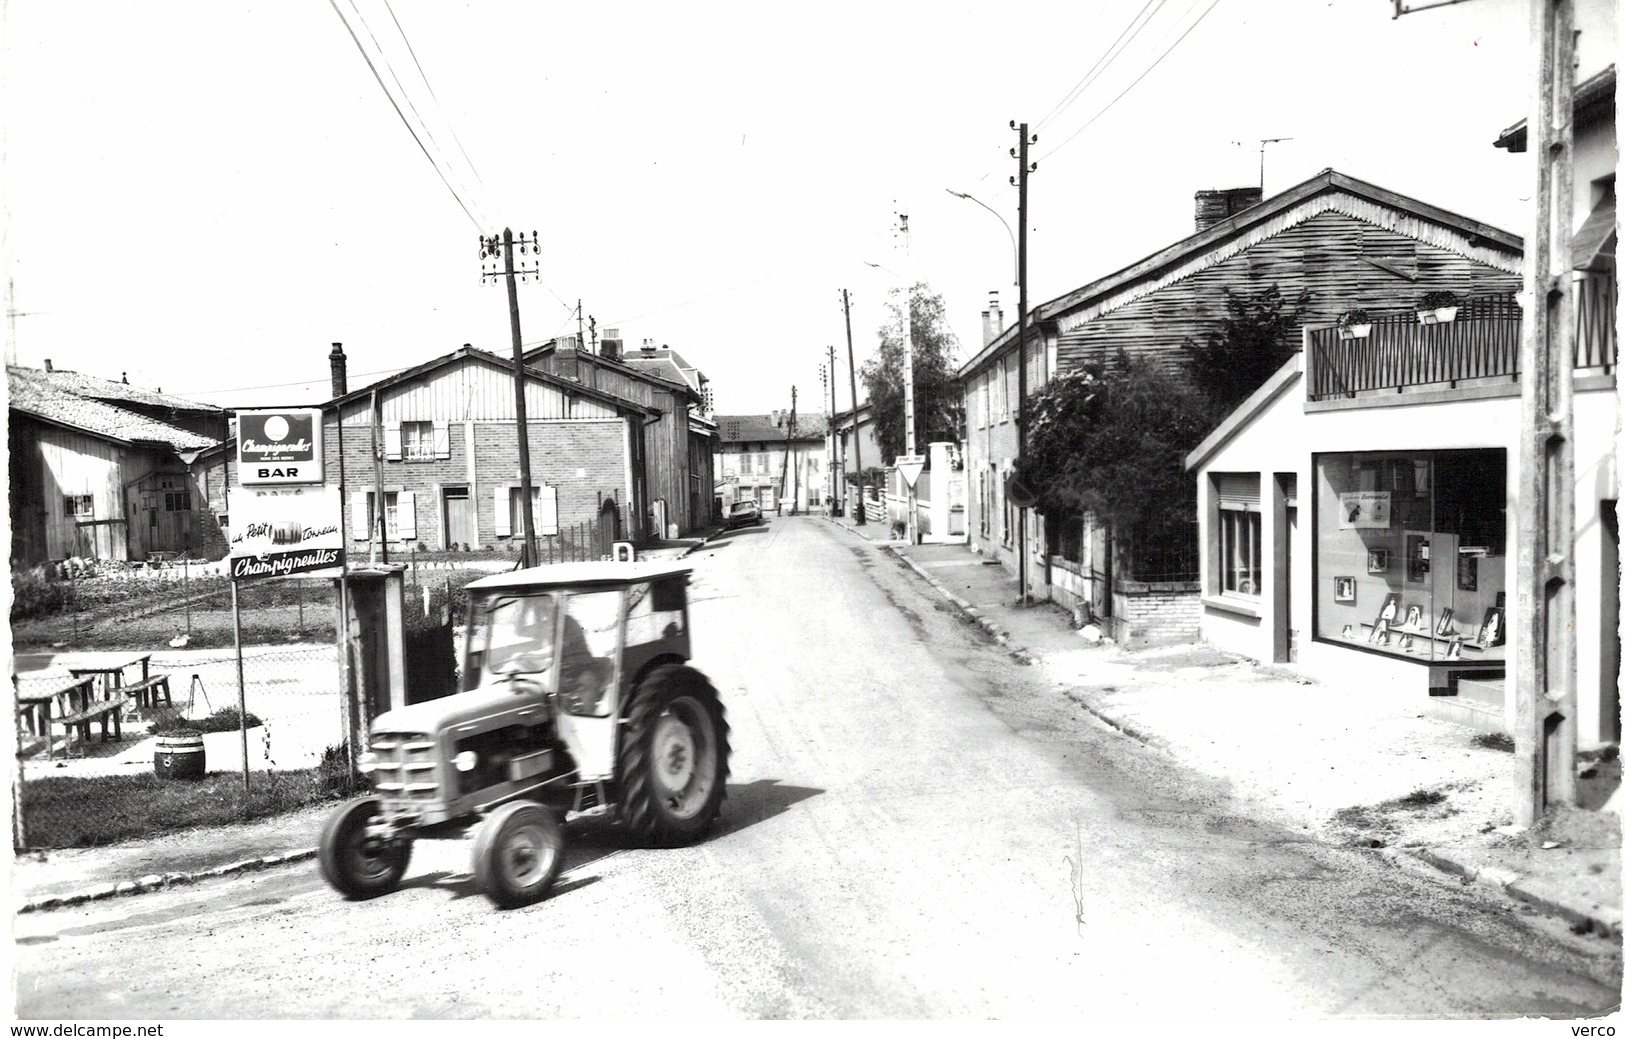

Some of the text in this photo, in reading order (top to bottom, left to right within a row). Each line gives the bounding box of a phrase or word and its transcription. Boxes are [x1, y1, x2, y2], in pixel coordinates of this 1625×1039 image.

[242, 438, 312, 456] Champigneulles
[258, 468, 299, 478] BAR
[246, 522, 268, 539] Petit
[302, 525, 338, 541] Tonneau
[234, 549, 339, 577] Champigneulles
